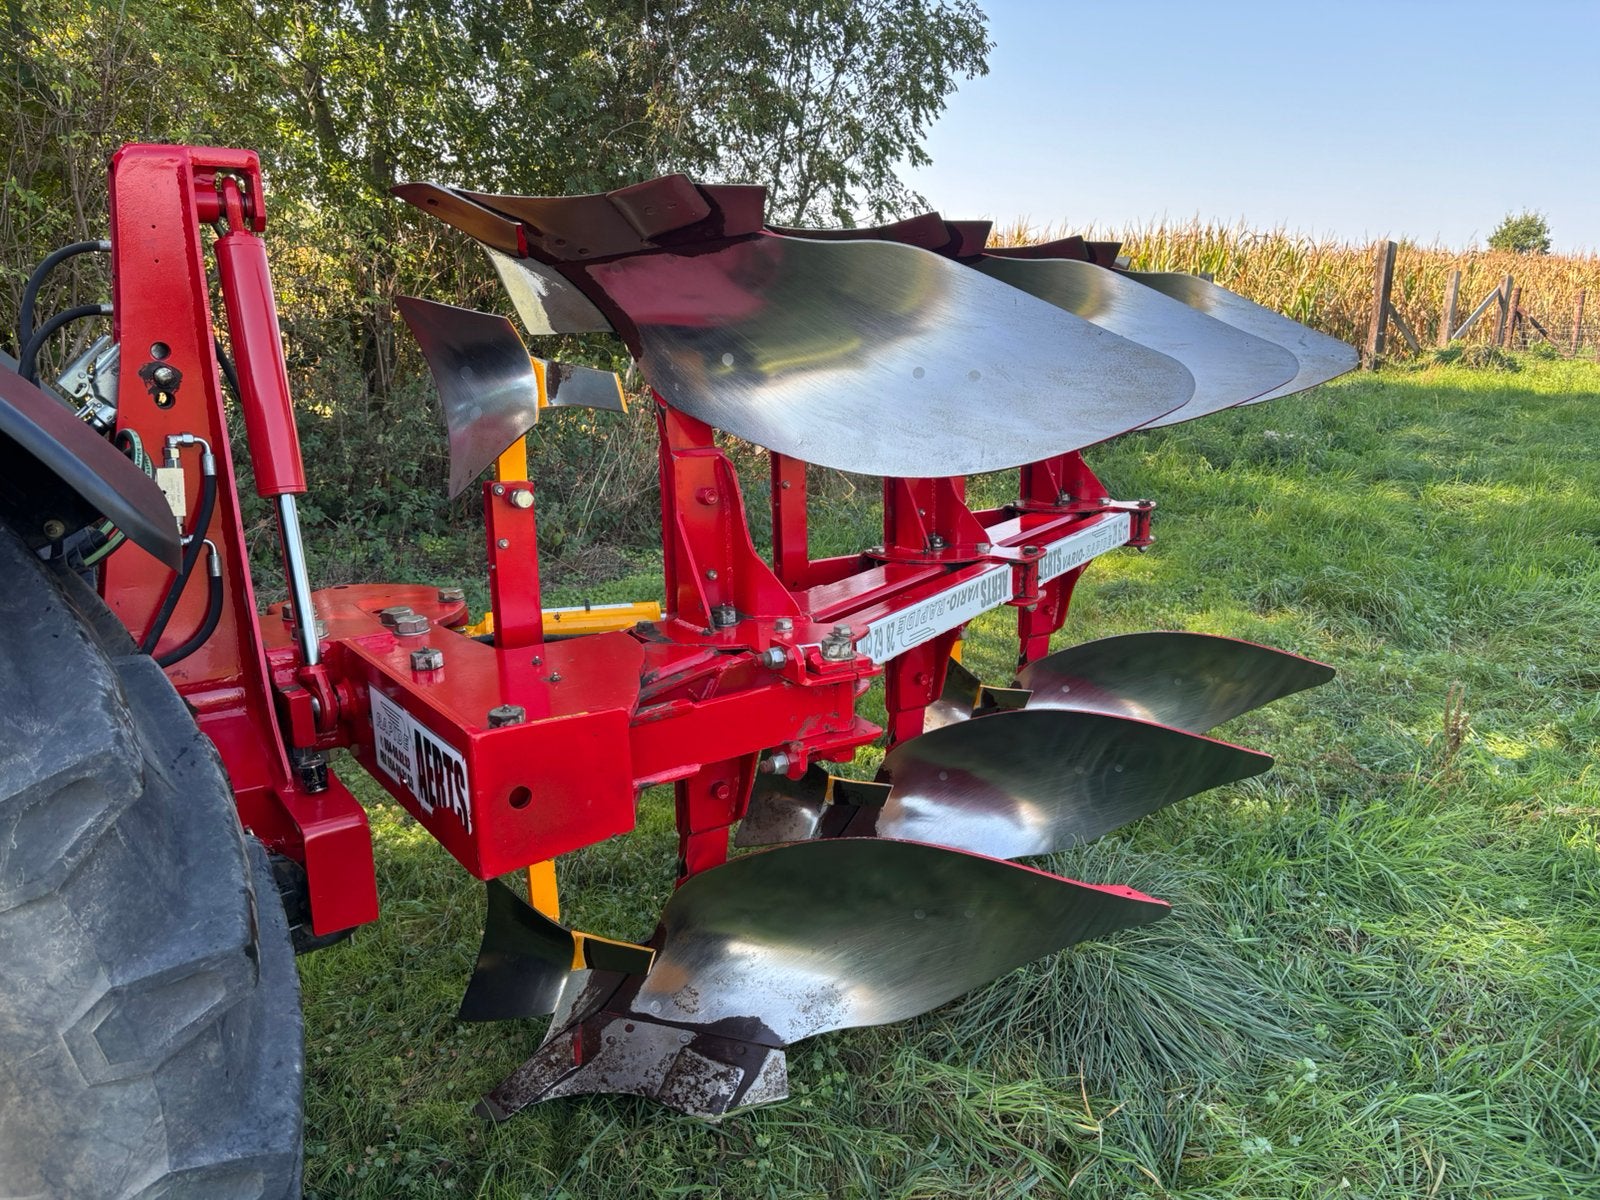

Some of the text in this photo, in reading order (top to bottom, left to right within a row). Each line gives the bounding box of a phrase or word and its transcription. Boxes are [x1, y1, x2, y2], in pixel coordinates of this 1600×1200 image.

[981, 569, 1009, 608] AERTS
[874, 625, 883, 659] 62
[886, 621, 895, 653] 28
[414, 728, 471, 834] AERTS
